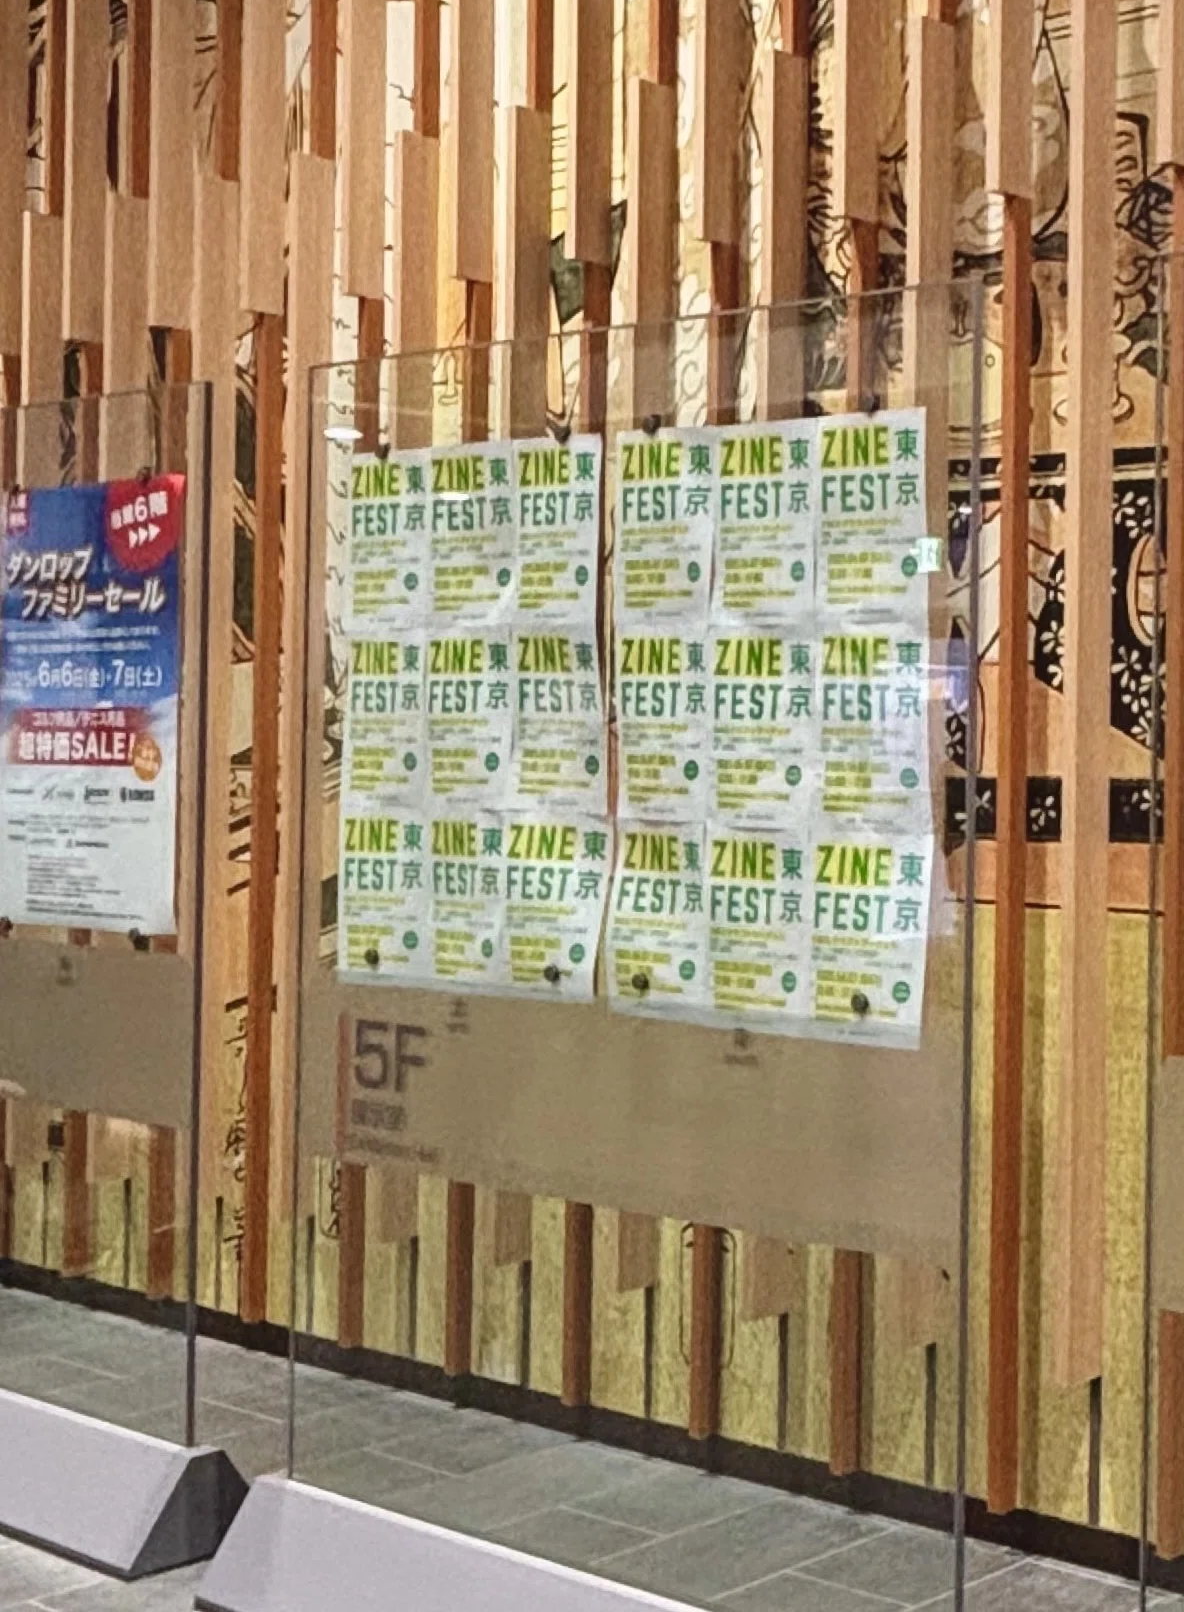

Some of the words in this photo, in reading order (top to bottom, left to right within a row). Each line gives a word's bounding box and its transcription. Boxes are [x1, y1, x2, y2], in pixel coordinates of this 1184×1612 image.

[622, 441, 683, 480] ZINE
[719, 436, 783, 478] ZINE
[821, 426, 890, 469] ZINE
[352, 463, 400, 498] ZINE
[432, 455, 484, 493] ZINE
[518, 449, 571, 487] ZINE
[519, 491, 571, 528] FEST
[622, 485, 682, 524] FEST
[720, 481, 785, 521] FEST
[821, 472, 891, 514] FEST
[352, 502, 402, 537] FEST
[432, 496, 487, 533] FEST
[6, 546, 93, 585] ダンロップ
[21, 577, 166, 621] ファミリーセール
[352, 641, 399, 675] ZINE
[429, 638, 483, 674] ZINE
[518, 636, 573, 673] ZINE
[620, 637, 681, 676] ZINE
[714, 638, 783, 677] ZINE
[822, 637, 890, 677] ZINE
[351, 680, 399, 714] FEST
[428, 679, 484, 714] FEST
[518, 678, 575, 714] FEST
[621, 681, 681, 718] FEST
[713, 683, 784, 721] FEST
[822, 683, 890, 721] FEST
[344, 818, 399, 853] ZINE
[431, 819, 478, 857] ZINE
[506, 823, 577, 861] ZINE
[624, 832, 680, 872] ZINE
[343, 857, 398, 891] FEST
[432, 860, 478, 897] FEST
[710, 839, 776, 881] ZINE
[815, 844, 893, 886] ZINE
[506, 864, 574, 901] FEST
[616, 876, 682, 915] FEST
[710, 885, 777, 925] FEST
[813, 890, 891, 933] FEST
[354, 1018, 428, 1093] 5F
